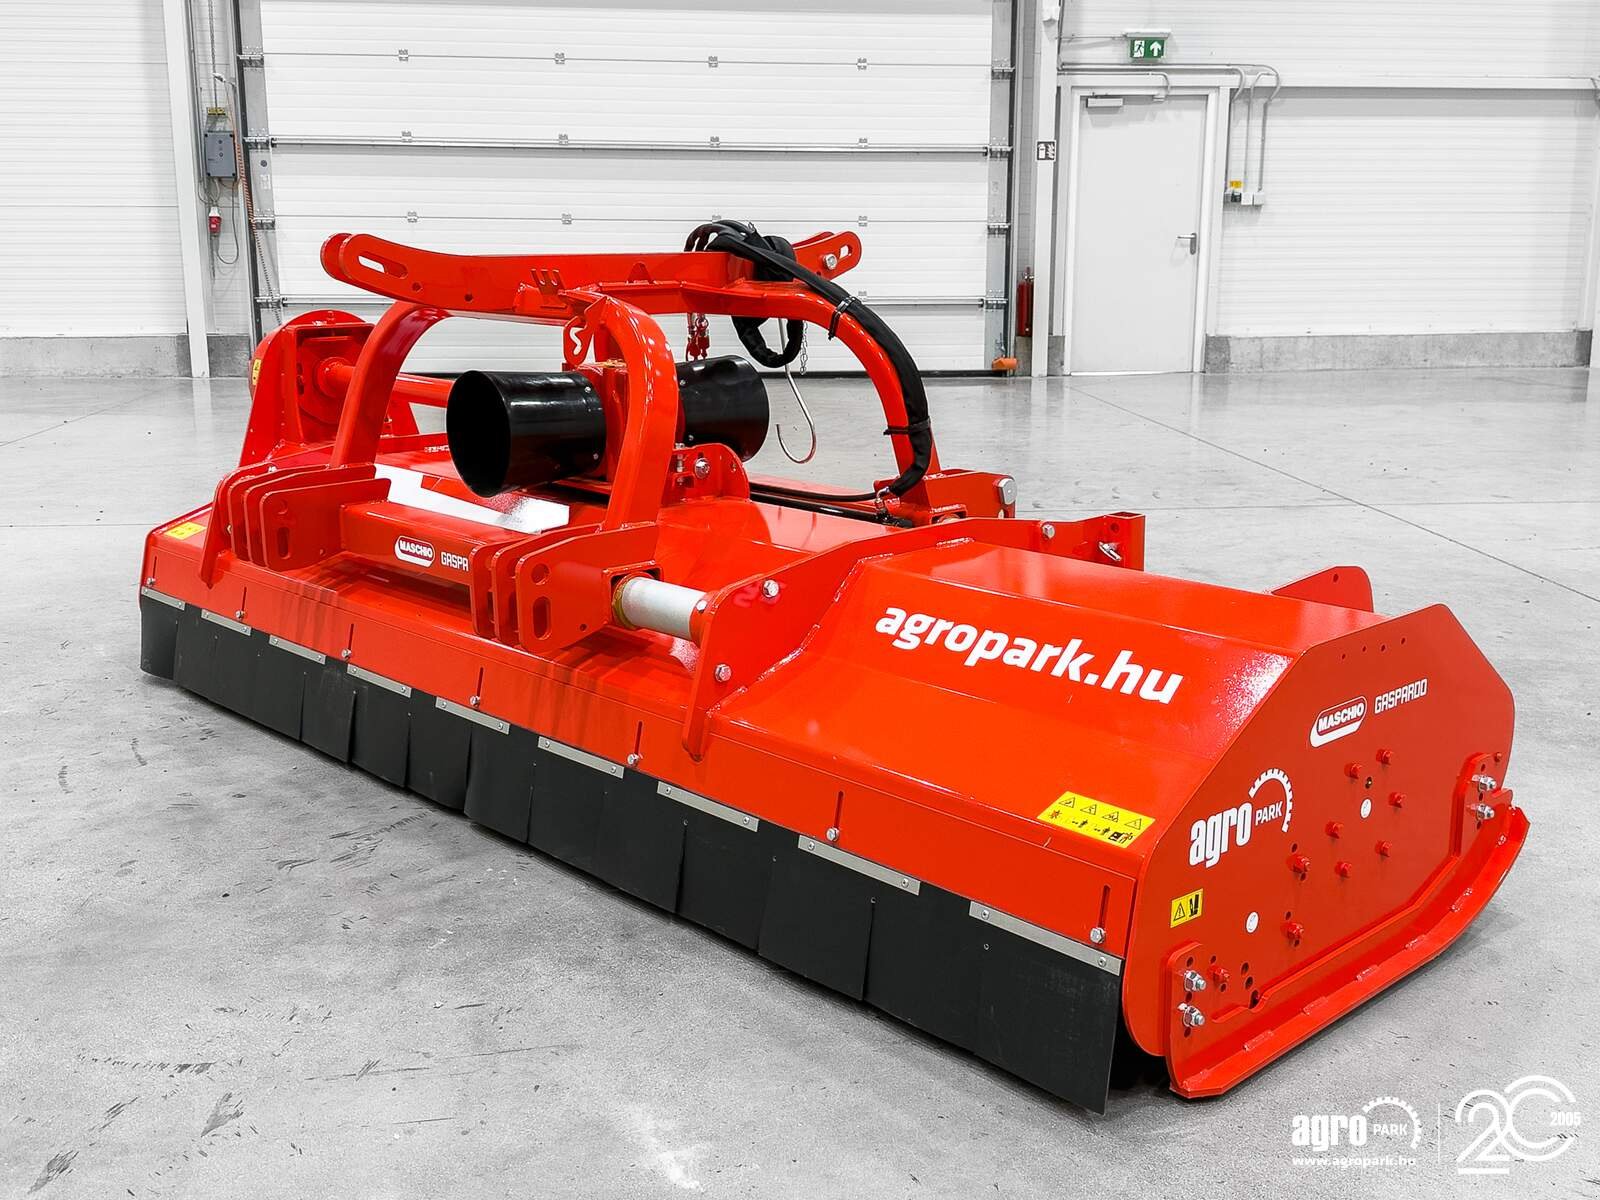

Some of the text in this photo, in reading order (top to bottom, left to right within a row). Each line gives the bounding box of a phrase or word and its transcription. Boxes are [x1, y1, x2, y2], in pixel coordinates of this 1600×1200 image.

[399, 540, 469, 571] MASCHIO GASPA
[875, 606, 1184, 705] agropark.hu
[1318, 678, 1428, 732] MASCHIO GASPARDO
[1189, 801, 1283, 868] agro PARK
